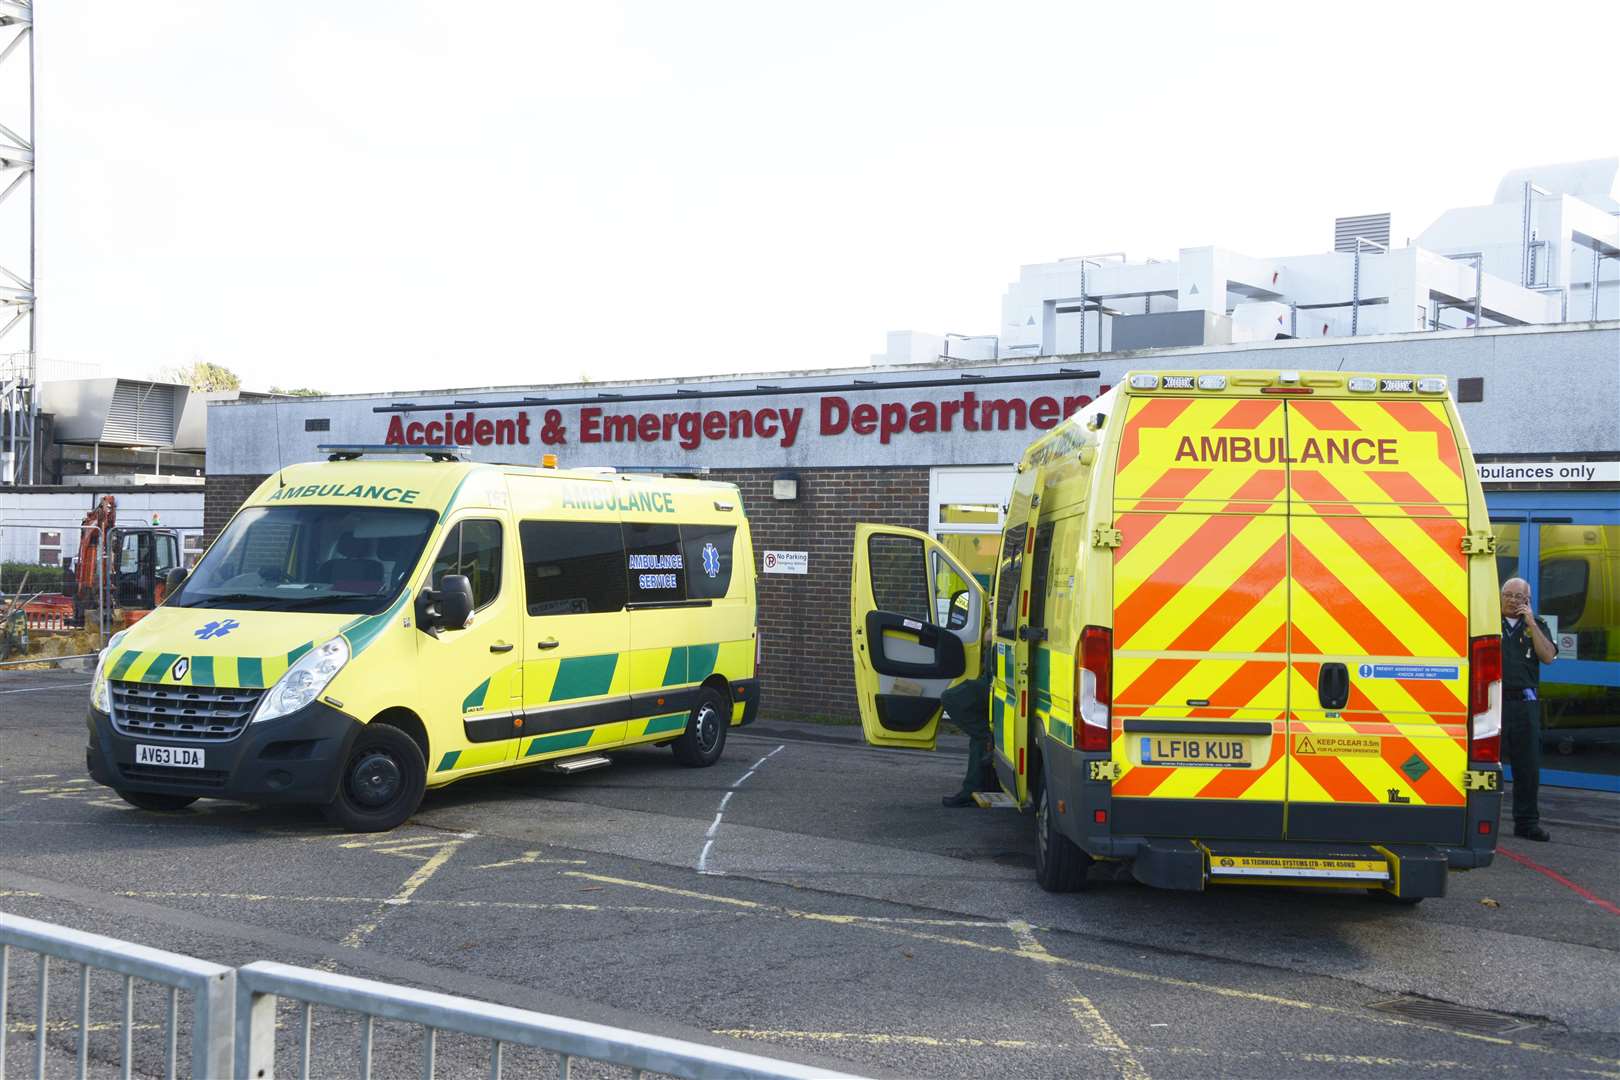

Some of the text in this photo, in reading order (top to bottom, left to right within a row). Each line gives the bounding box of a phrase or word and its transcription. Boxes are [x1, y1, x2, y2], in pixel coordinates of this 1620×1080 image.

[385, 385, 1111, 450] Accident & Emergency Departmen
[1175, 435, 1399, 465] AMBULANCE
[1477, 465, 1595, 480] bulances only
[267, 484, 420, 504] AMBULANCE
[561, 489, 675, 513] AMBULANCE
[629, 554, 683, 569] AMBULANCE
[786, 553, 806, 561] Parking
[639, 574, 677, 589] SERVICE
[141, 747, 199, 765] AV63 LDA
[1157, 740, 1243, 759] LF18 KUB
